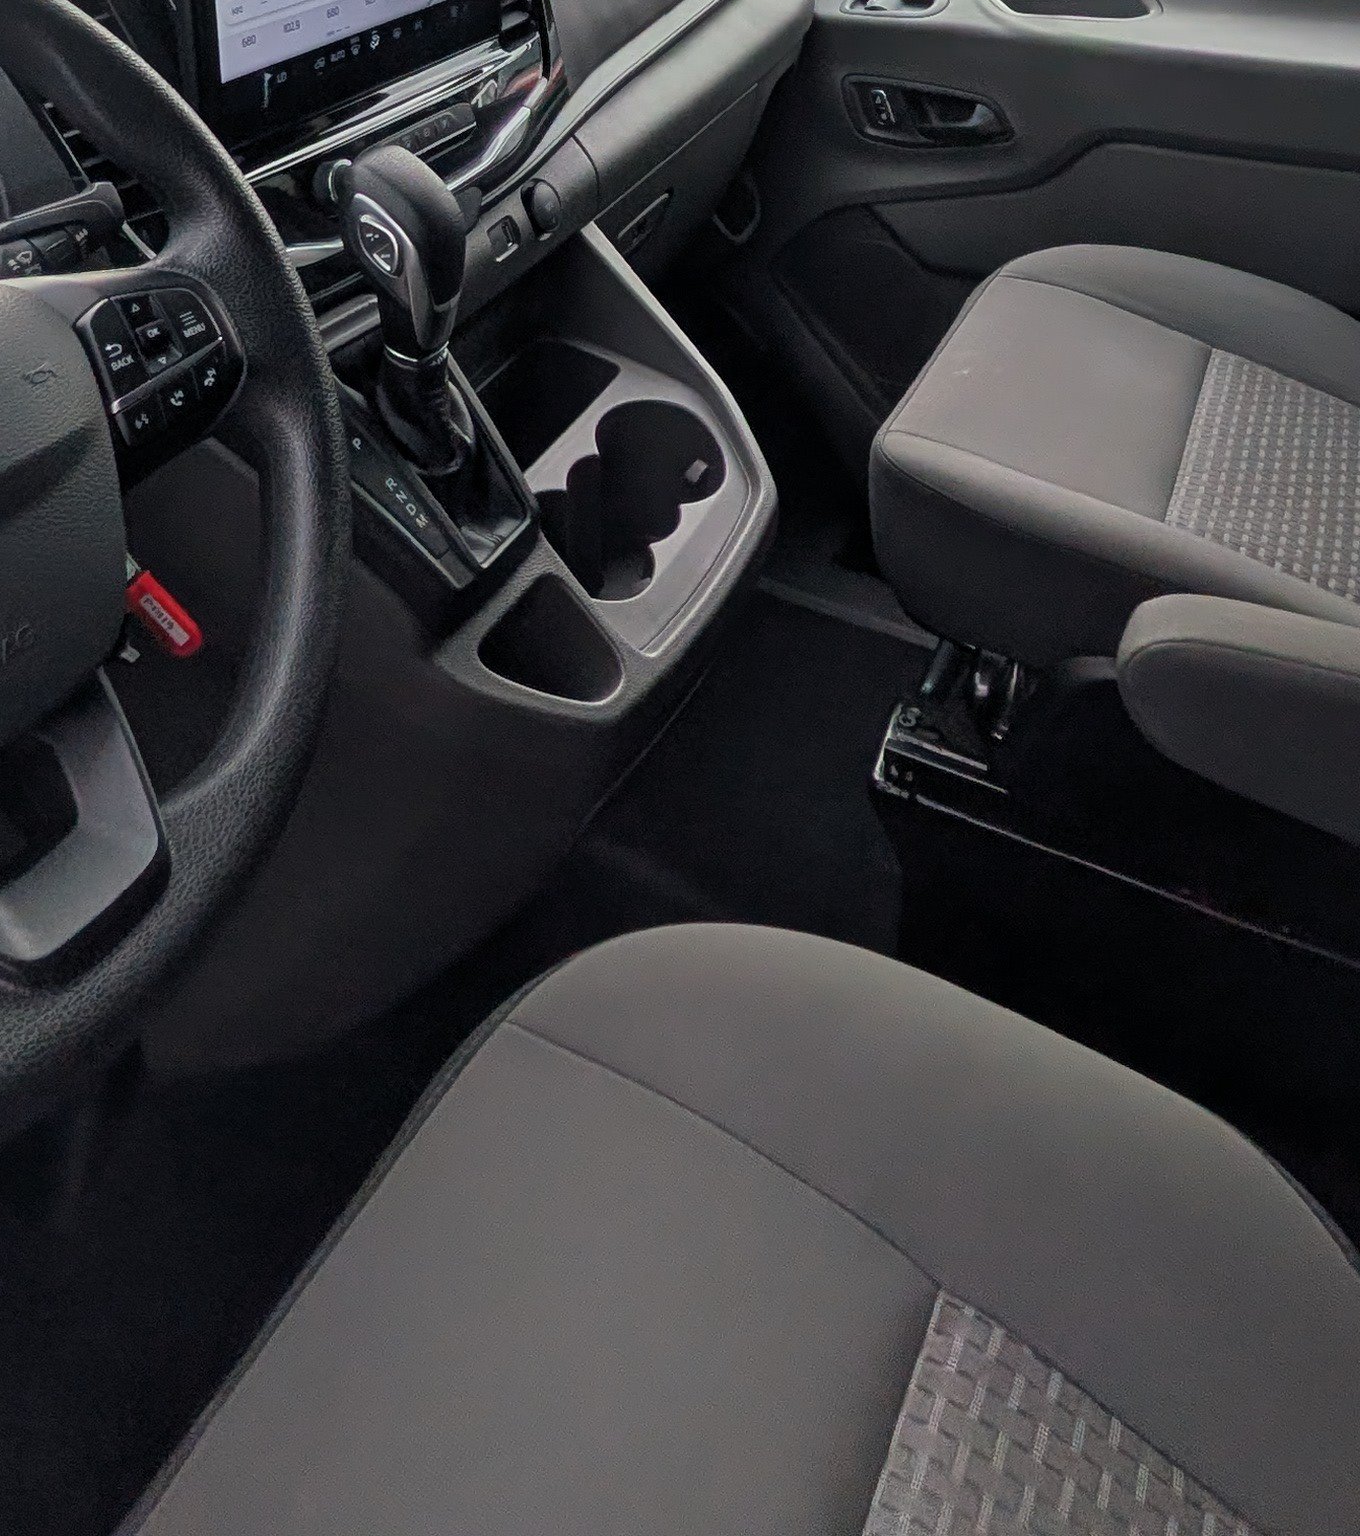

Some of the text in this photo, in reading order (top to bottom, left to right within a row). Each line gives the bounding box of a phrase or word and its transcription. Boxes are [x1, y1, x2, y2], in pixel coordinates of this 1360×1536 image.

[182, 322, 206, 338] MENU
[110, 354, 136, 372] BACK
[352, 437, 362, 451] P
